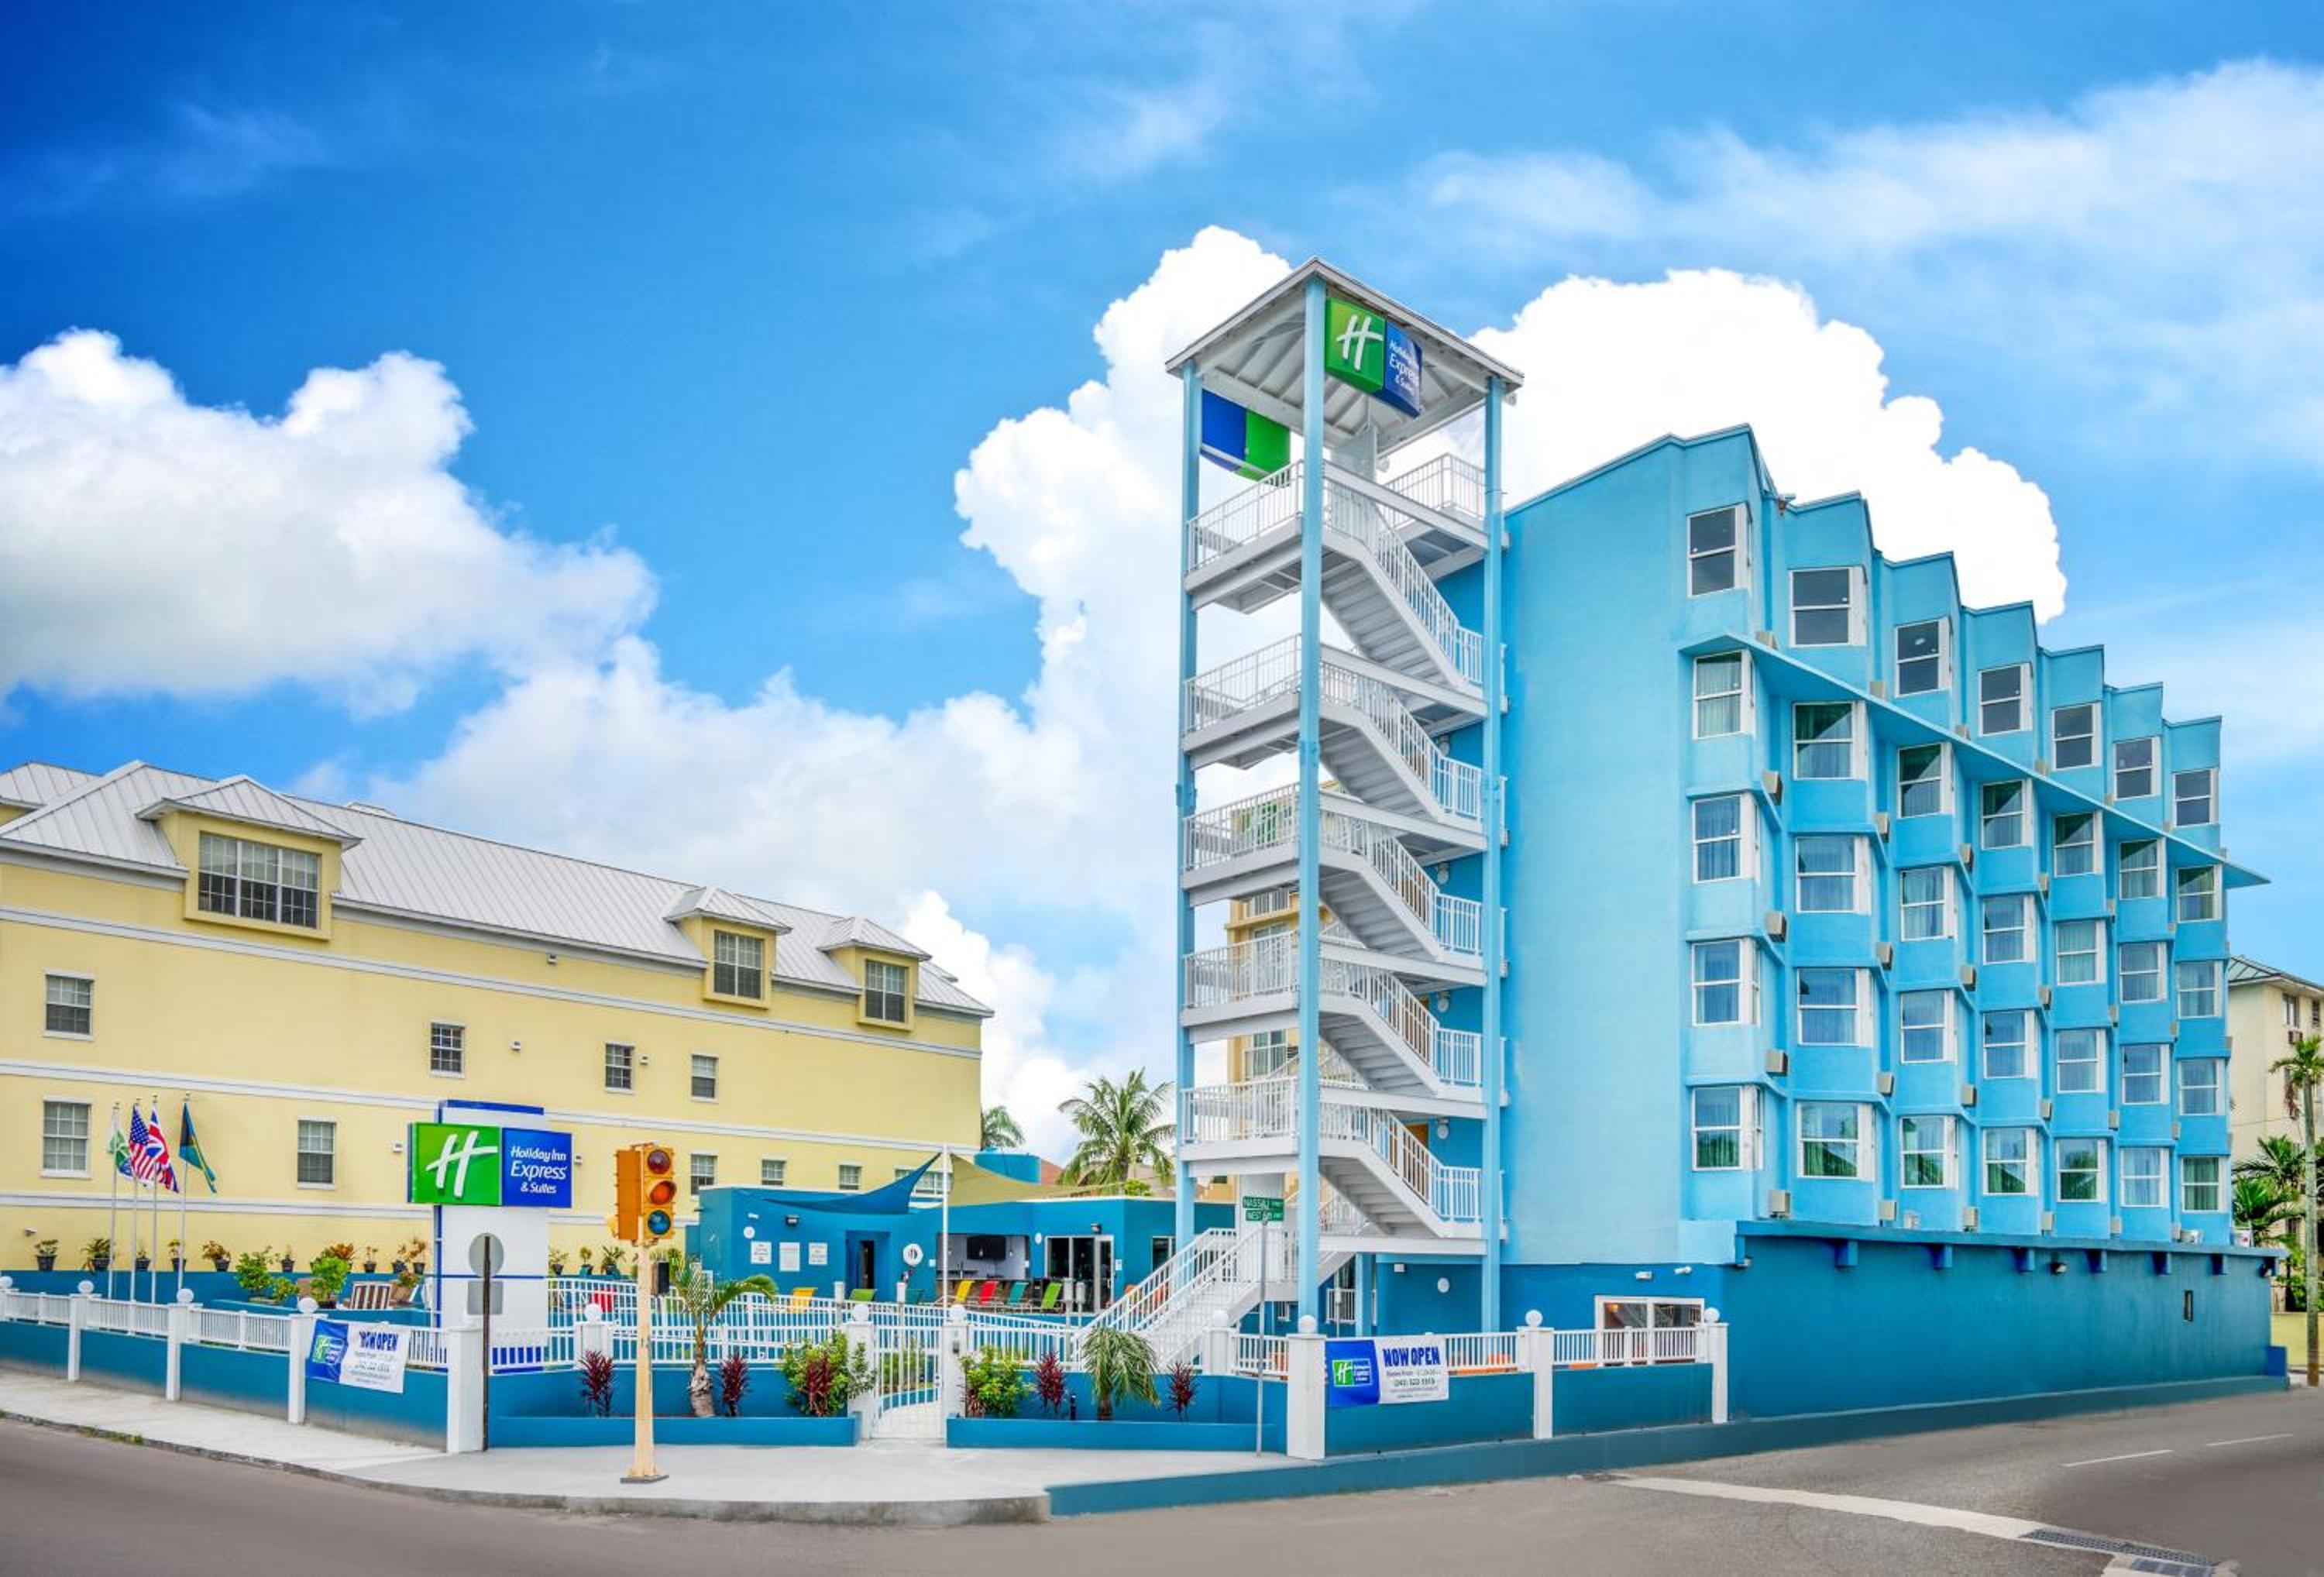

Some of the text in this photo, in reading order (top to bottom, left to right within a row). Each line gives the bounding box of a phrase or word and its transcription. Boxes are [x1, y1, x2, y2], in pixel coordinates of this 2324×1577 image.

[511, 1146, 566, 1162] Holiday Inn
[511, 1160, 567, 1181] Express
[521, 1182, 557, 1194] & Suites
[1383, 1346, 1440, 1368] NOW OPEN
